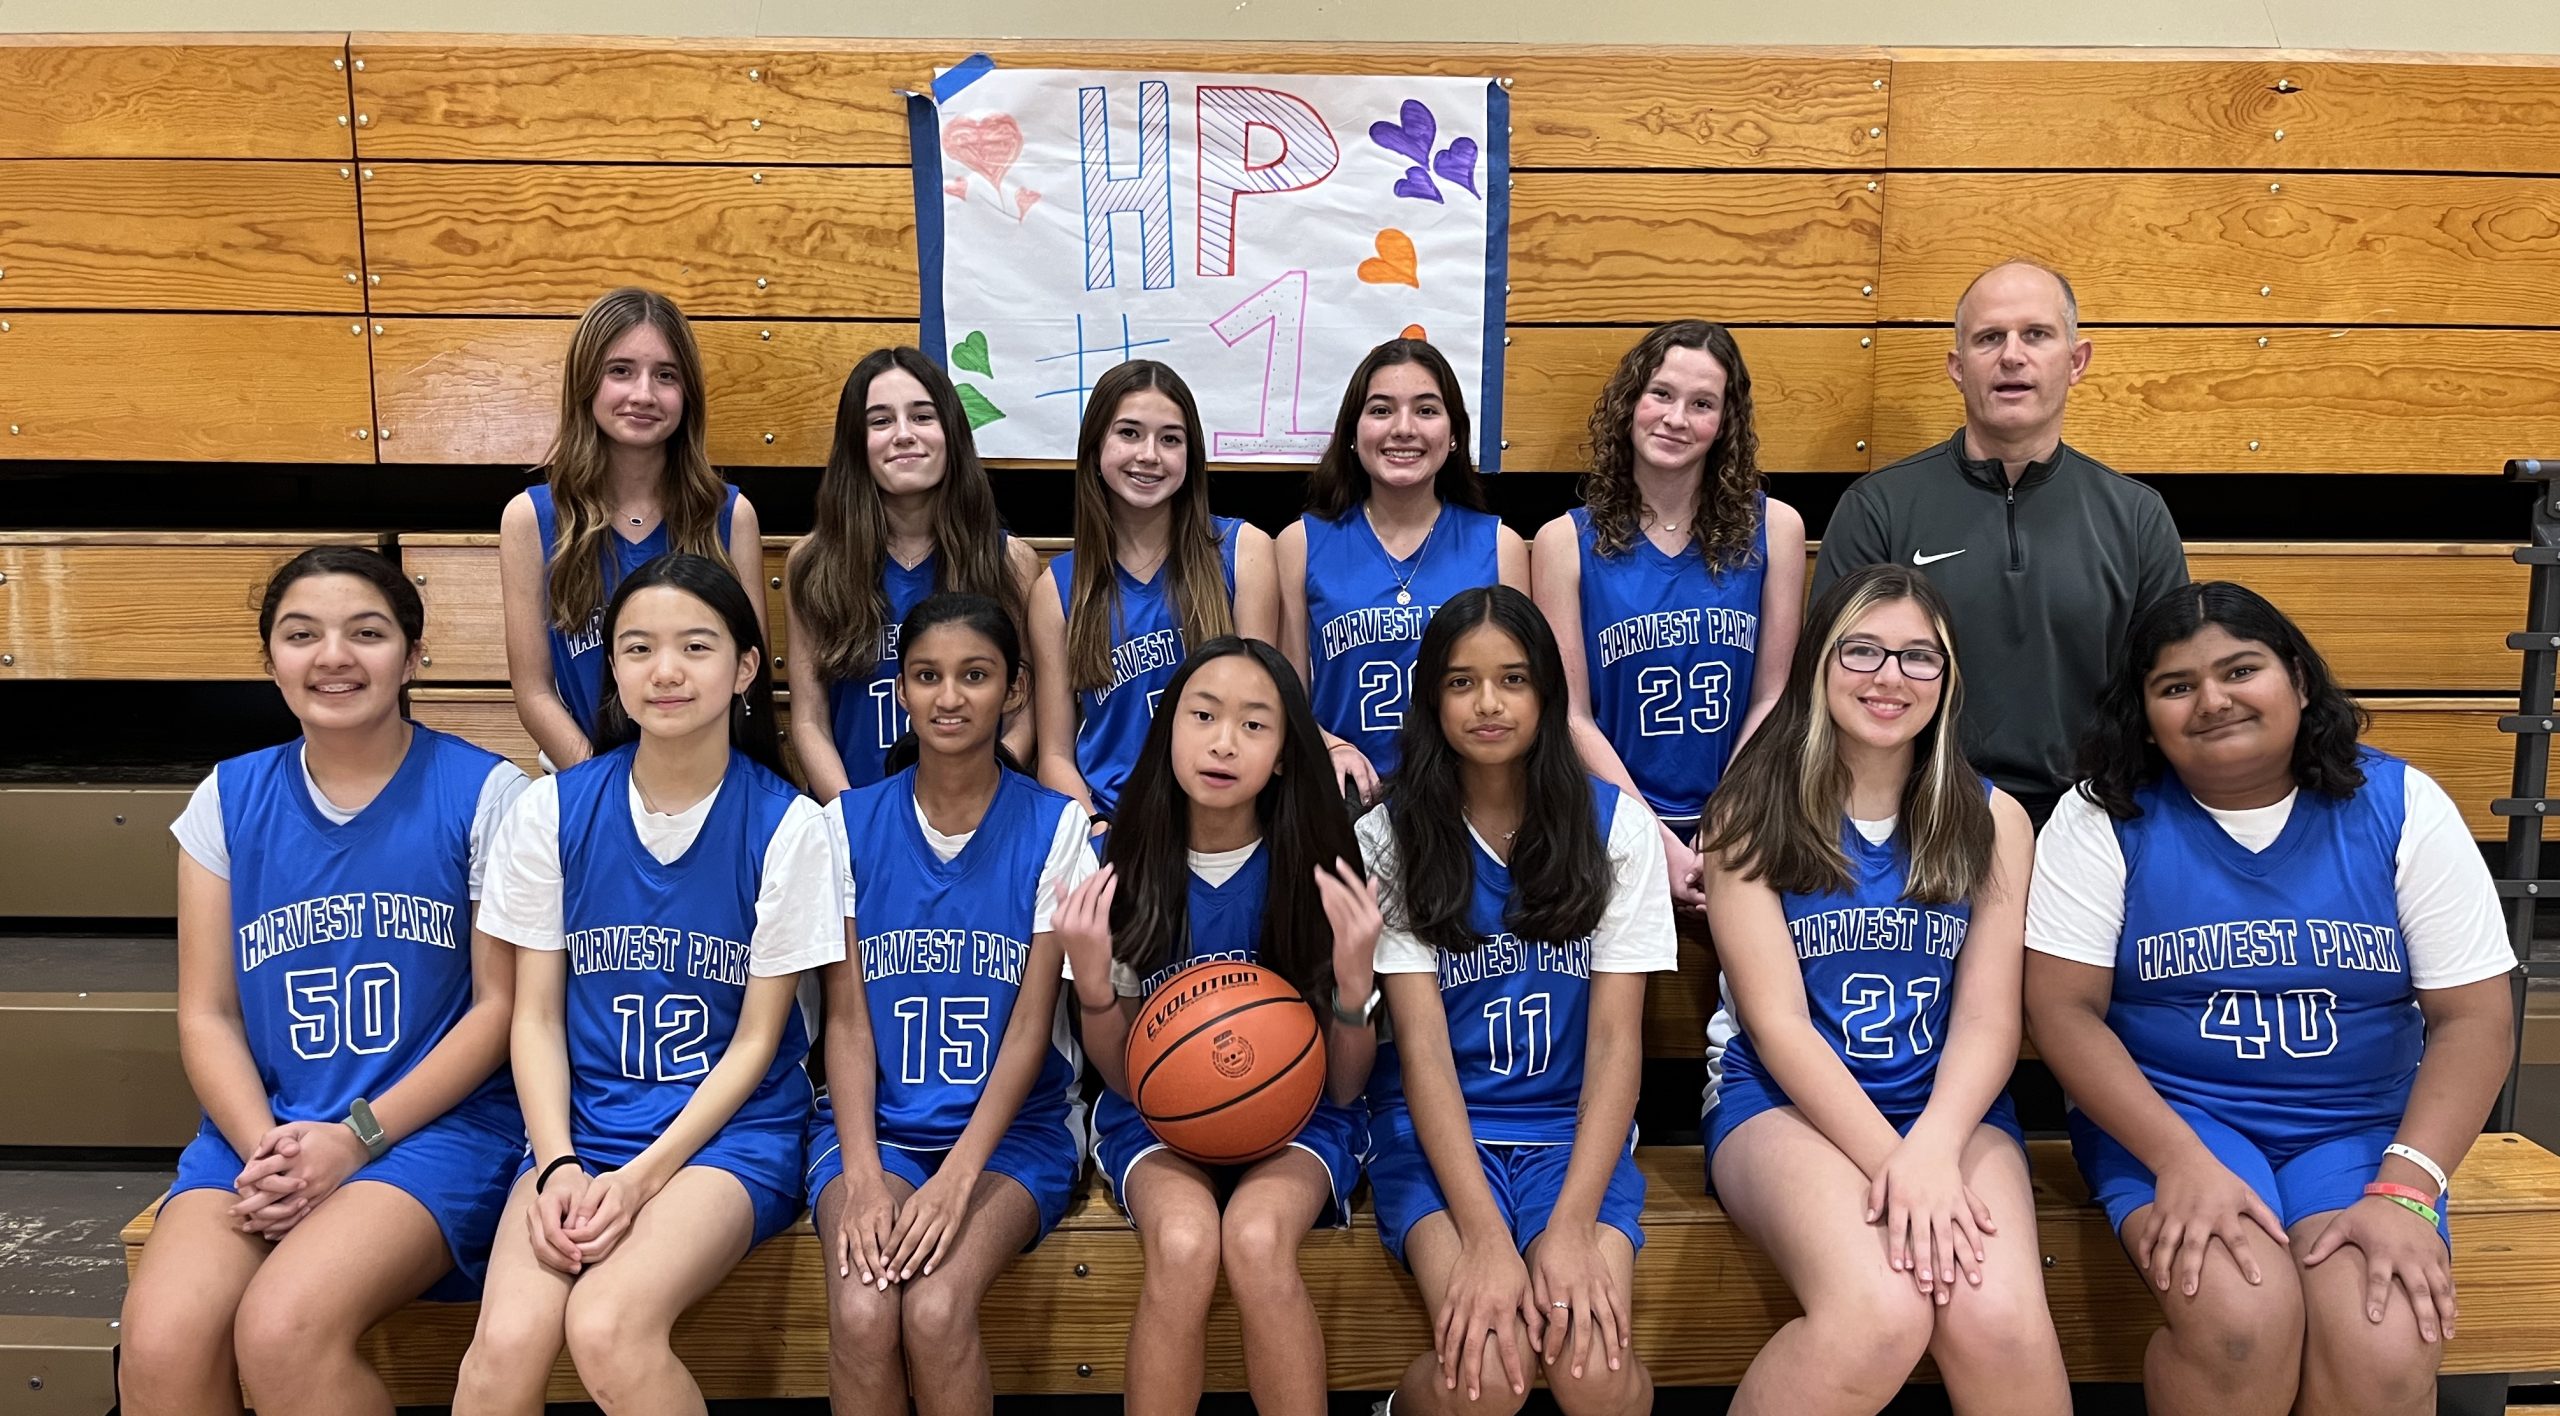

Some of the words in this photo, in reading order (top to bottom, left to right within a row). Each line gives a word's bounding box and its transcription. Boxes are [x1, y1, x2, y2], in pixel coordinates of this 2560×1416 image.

[1079, 80, 1340, 291] HP
[1094, 628, 1176, 706] RVEST
[1322, 606, 1422, 661] HARVEST
[1598, 608, 1701, 668] HARVEST
[1705, 607, 1757, 654] PARK
[1359, 660, 1418, 732] 2
[1637, 660, 1731, 737] 23
[240, 893, 366, 972] HARVEST
[372, 892, 456, 949] PARK
[688, 931, 751, 986] PARK
[858, 929, 965, 982] ARVEST
[972, 930, 1030, 986] PAR
[1435, 933, 1528, 991] ARVEST
[1537, 936, 1592, 980] PAR
[1788, 907, 1918, 960] HARVEST
[2137, 919, 2298, 981] HARVEST
[2306, 919, 2402, 973] PARK
[286, 961, 401, 1060] 50
[613, 994, 710, 1082] 12
[894, 996, 990, 1085] 15
[1146, 972, 1259, 1038] EVOLUTION
[1483, 992, 1551, 1077] 11
[1842, 973, 1941, 1059] 21
[2200, 988, 2339, 1060] 40
